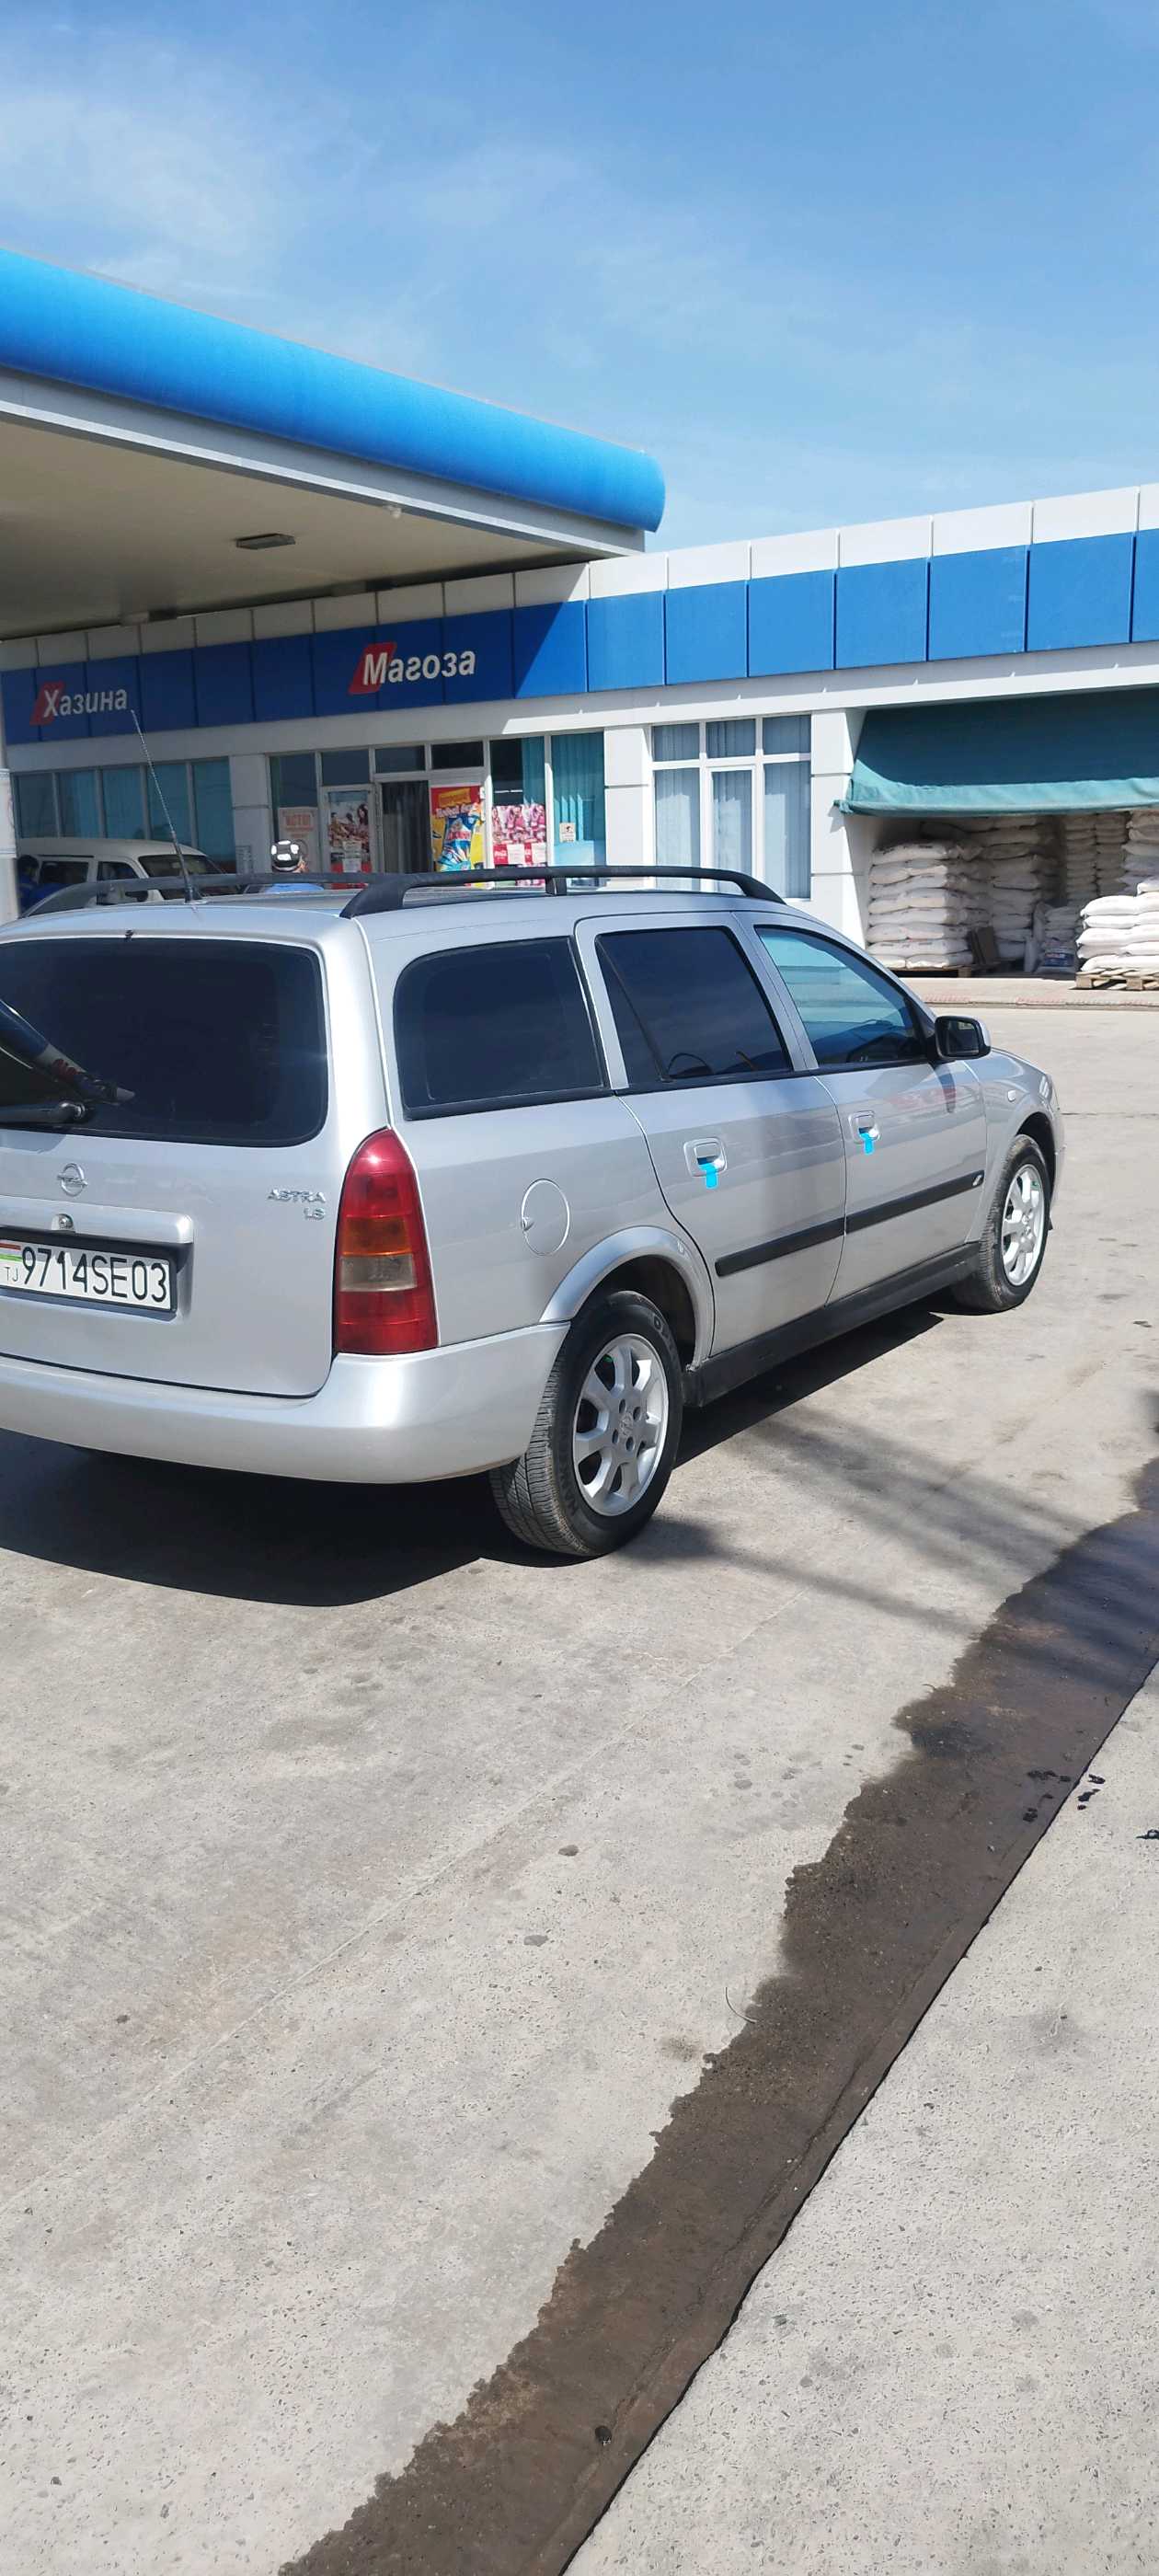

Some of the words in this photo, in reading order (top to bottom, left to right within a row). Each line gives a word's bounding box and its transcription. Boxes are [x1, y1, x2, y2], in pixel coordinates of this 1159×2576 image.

[363, 650, 476, 686] Магоза
[43, 688, 128, 718] Хазина
[267, 1189, 327, 1203] ASTRA
[5, 1266, 19, 1282] TJ
[22, 1246, 167, 1303] 9714SE03
